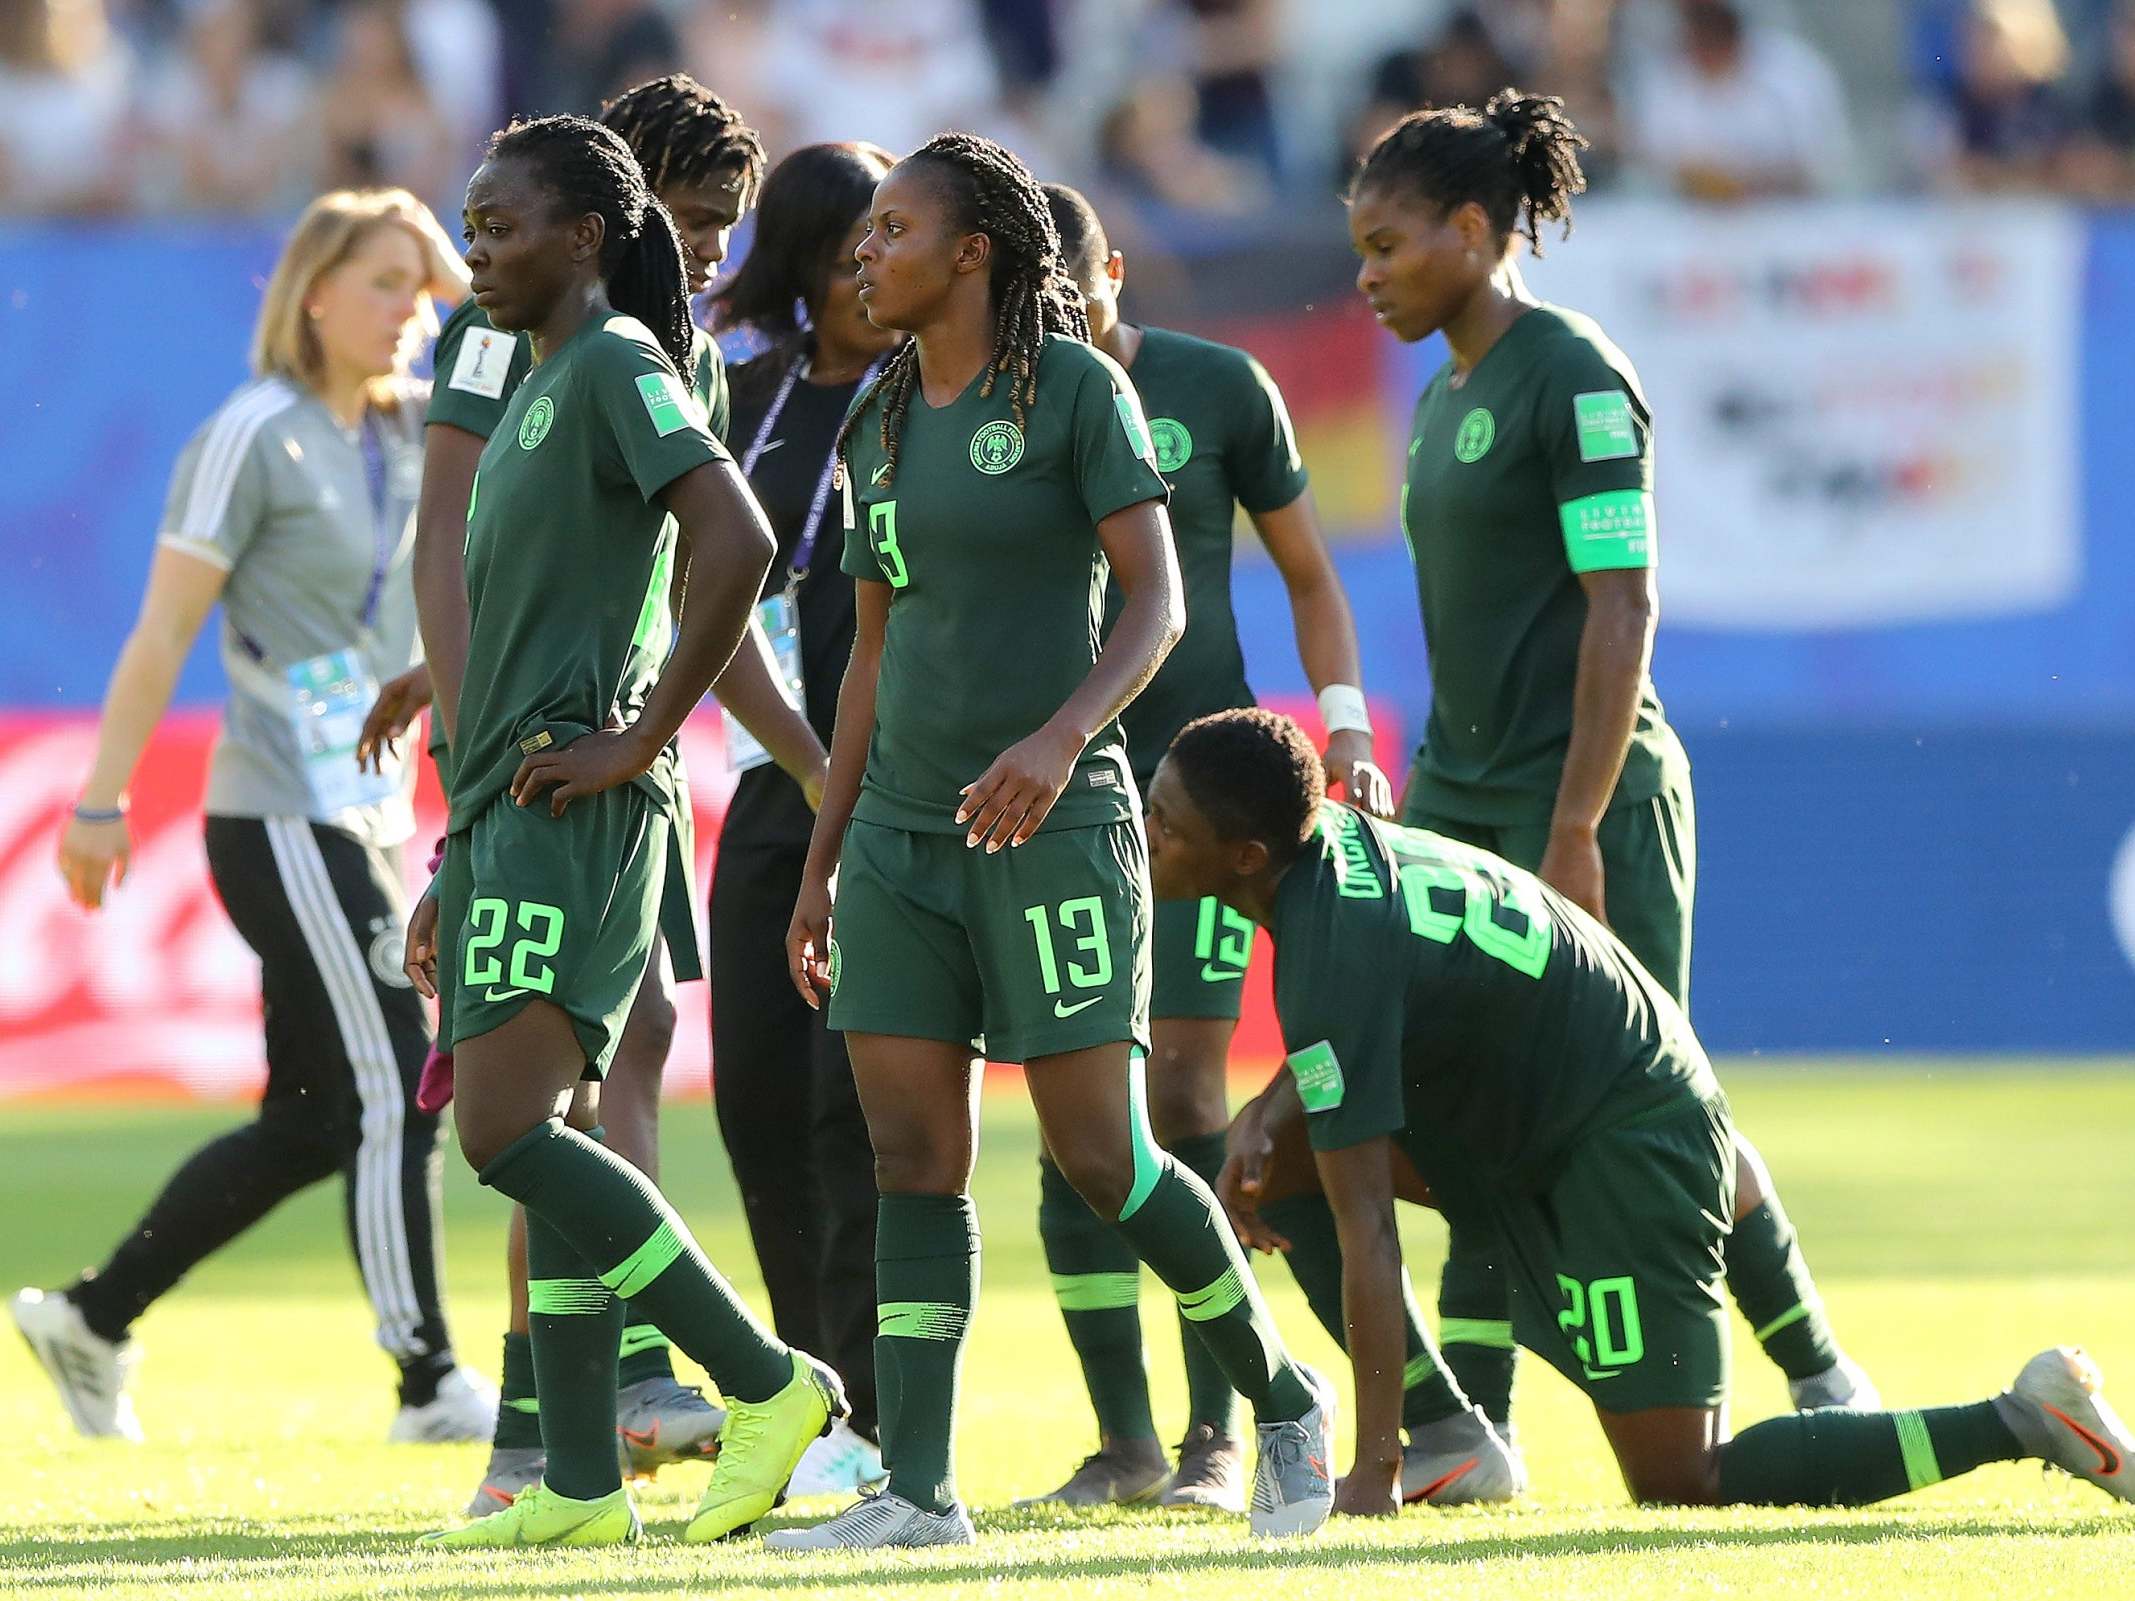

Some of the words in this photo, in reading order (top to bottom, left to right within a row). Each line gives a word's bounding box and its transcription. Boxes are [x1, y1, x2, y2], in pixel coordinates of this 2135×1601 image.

[977, 424, 1008, 442] FOOTBALL
[1580, 504, 1643, 520] LIVIN
[465, 898, 565, 994] 22
[1025, 896, 1113, 990] 13
[1195, 895, 1255, 969] 15
[1556, 1272, 1645, 1366] 20
